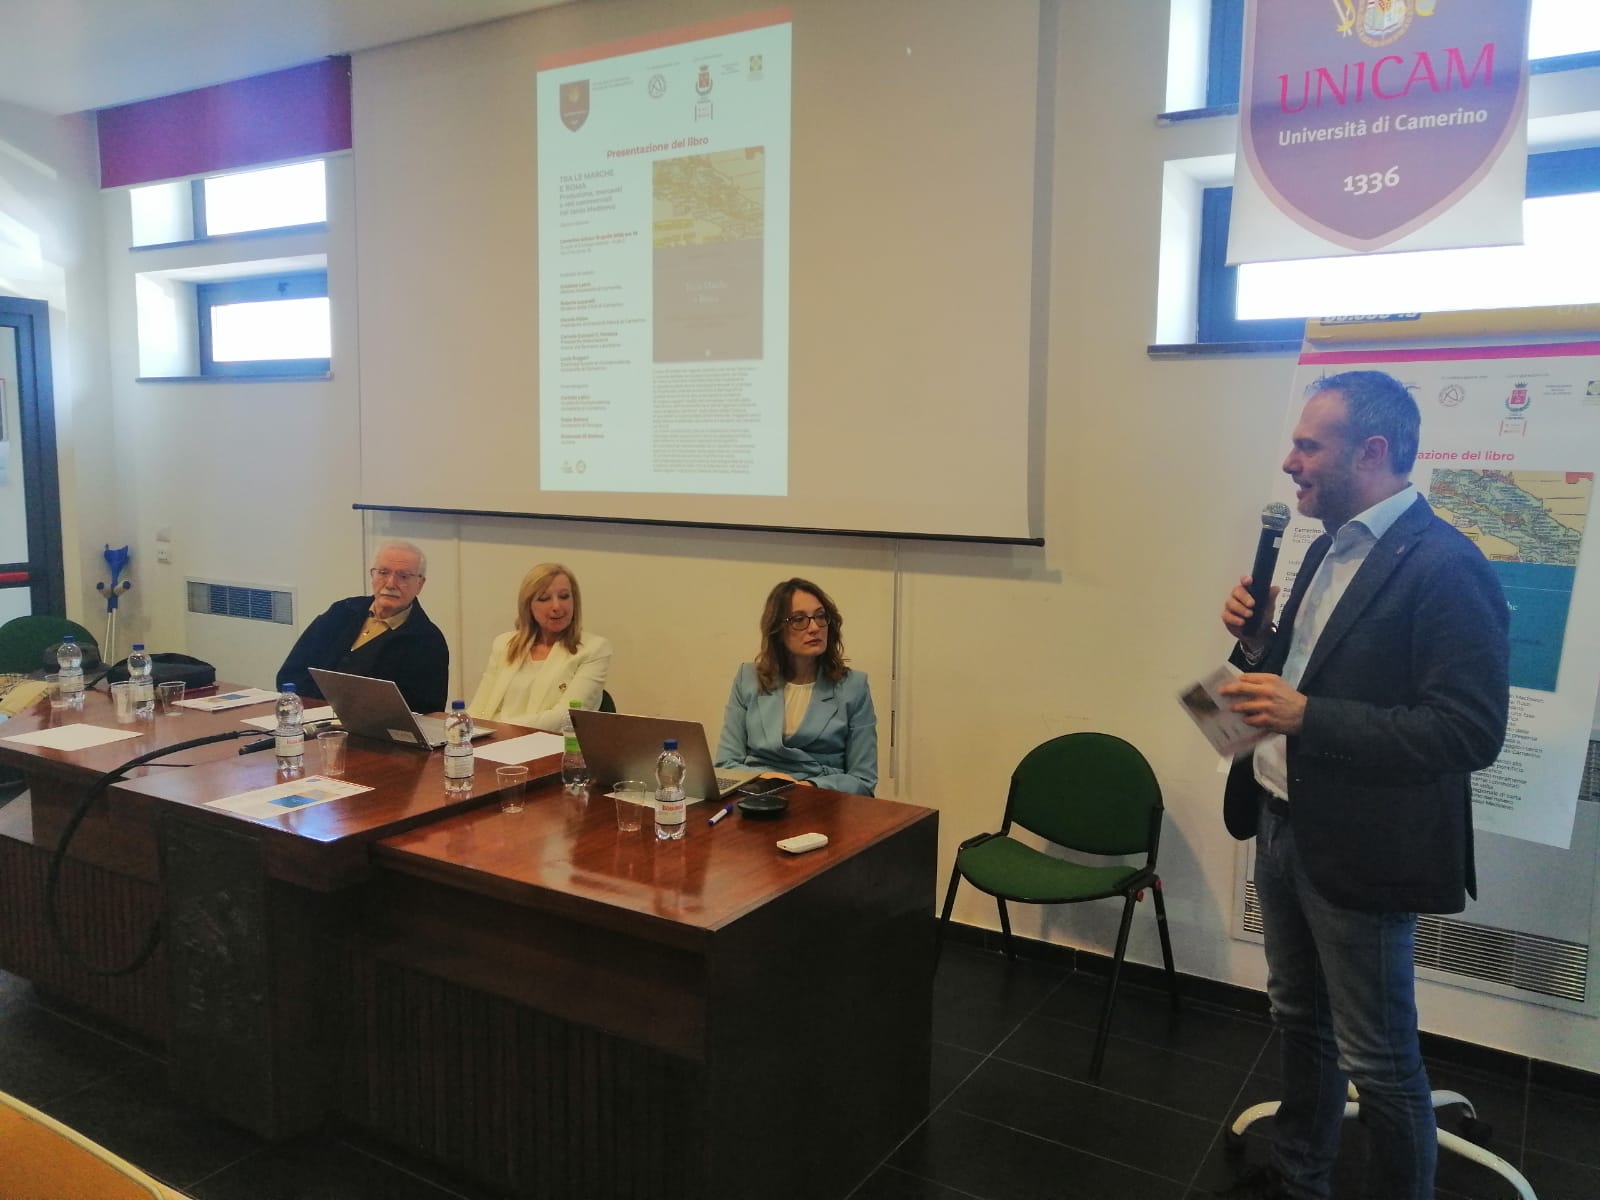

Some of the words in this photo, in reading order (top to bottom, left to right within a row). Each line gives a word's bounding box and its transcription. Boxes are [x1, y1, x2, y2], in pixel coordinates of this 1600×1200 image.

[1277, 43, 1496, 115] UNICAM
[1278, 119, 1367, 146] Università
[1372, 115, 1390, 134] di
[1395, 108, 1488, 131] Camerino
[607, 142, 670, 158] Presentazione
[671, 139, 686, 149] del
[687, 136, 709, 148] libro
[1343, 166, 1400, 195] 1336
[1417, 449, 1458, 460] azione
[1461, 450, 1481, 460] del
[1485, 451, 1515, 461] libro
